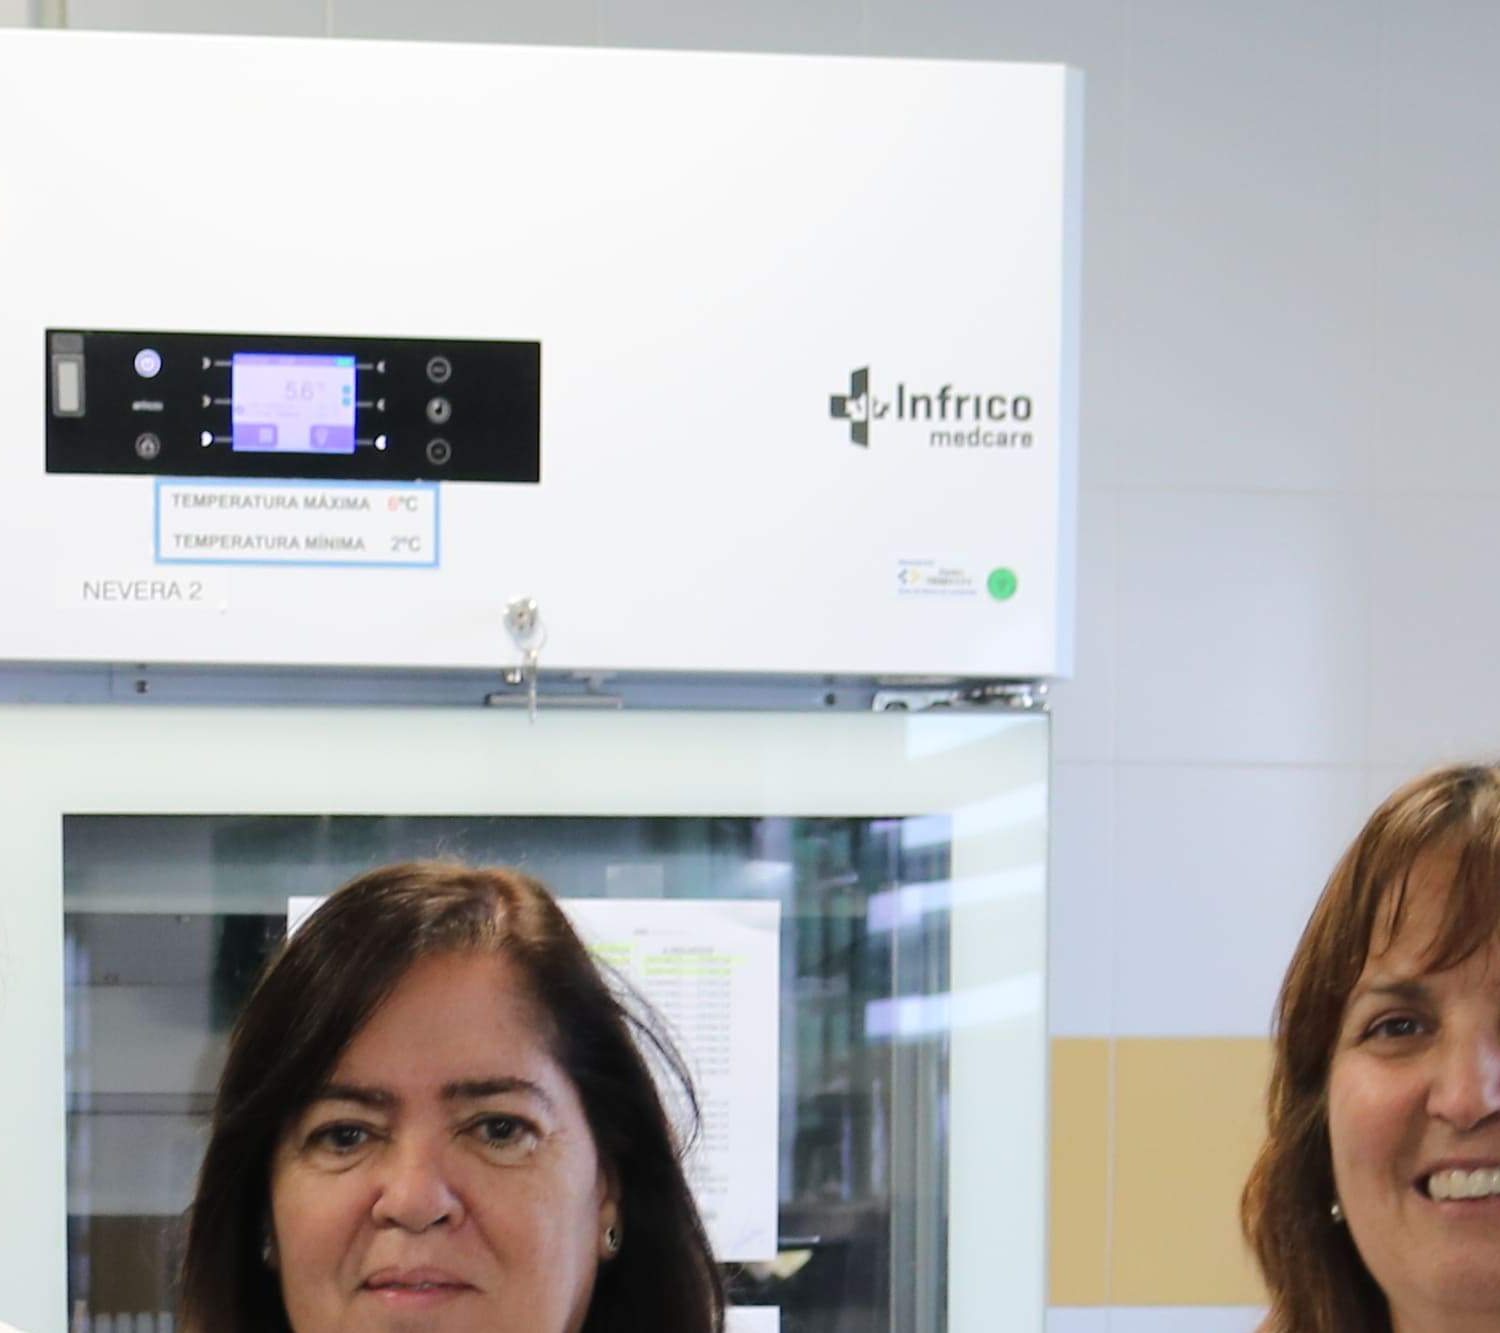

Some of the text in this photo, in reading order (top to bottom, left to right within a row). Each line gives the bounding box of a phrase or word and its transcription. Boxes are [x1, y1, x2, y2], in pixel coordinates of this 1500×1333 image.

[898, 382, 1033, 421] Infrico
[930, 428, 1033, 448] medcare
[171, 493, 299, 511] TEMPERATURA
[303, 492, 371, 511] MÁXIMA
[173, 533, 300, 551] TEMPERATURA
[305, 533, 366, 552] MÍNIMA
[83, 580, 203, 601] NEVERA 2
